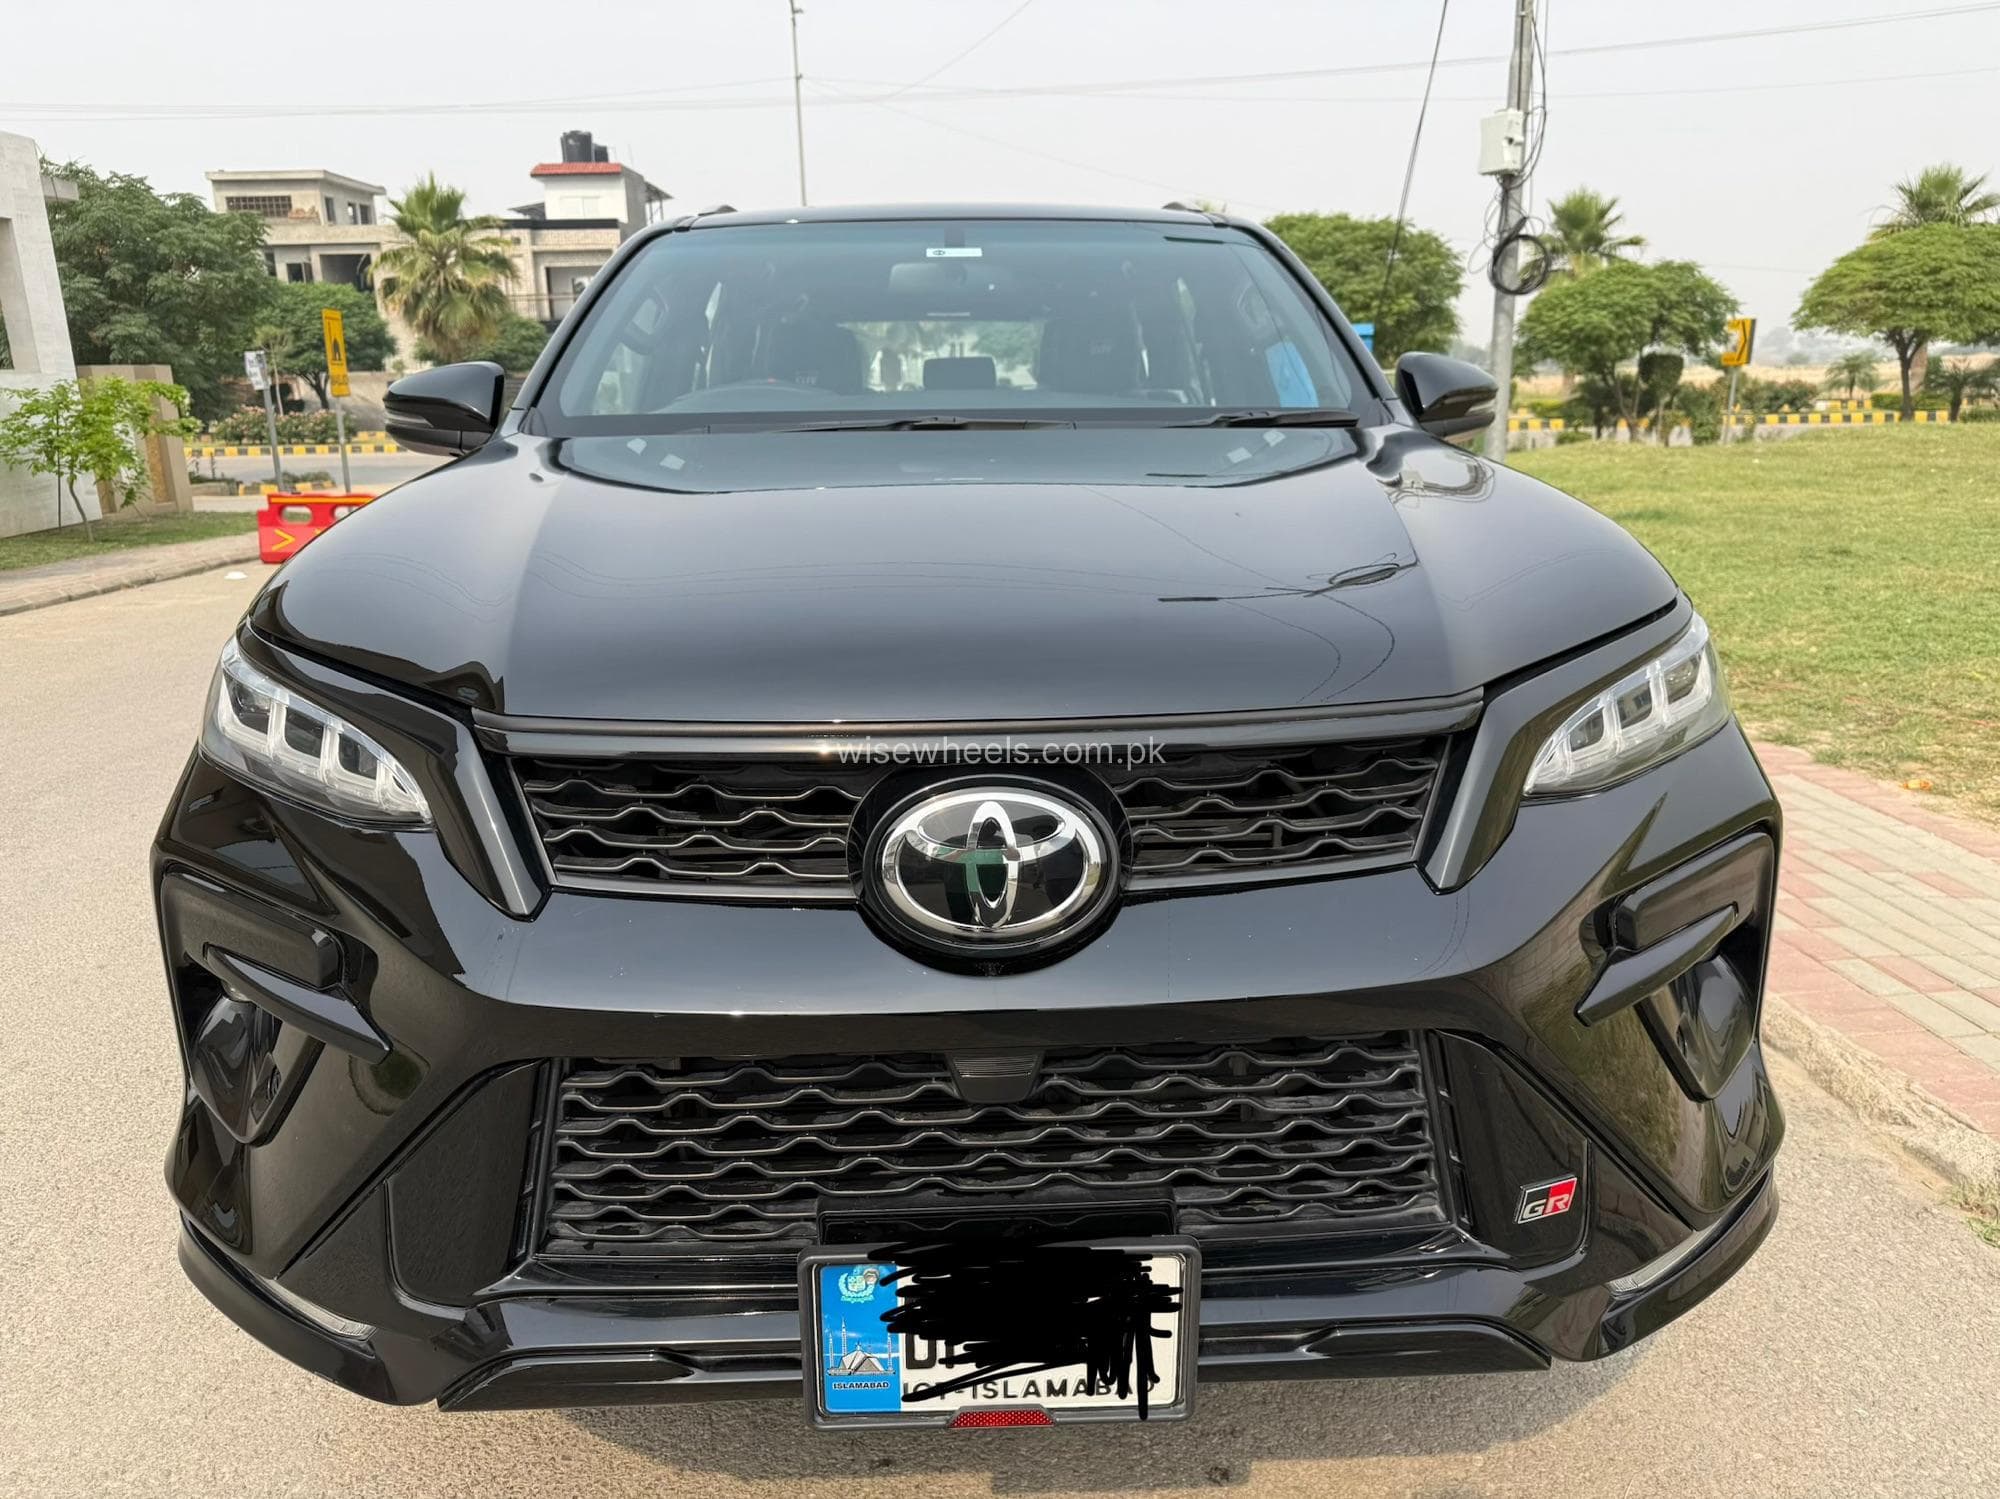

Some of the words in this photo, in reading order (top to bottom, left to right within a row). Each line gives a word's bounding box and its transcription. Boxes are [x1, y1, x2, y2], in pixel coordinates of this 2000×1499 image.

[1522, 1193, 1570, 1219] GR
[833, 1381, 890, 1390] ISLAMABAD
[903, 1378, 1155, 1400] I-ISLAMAB
